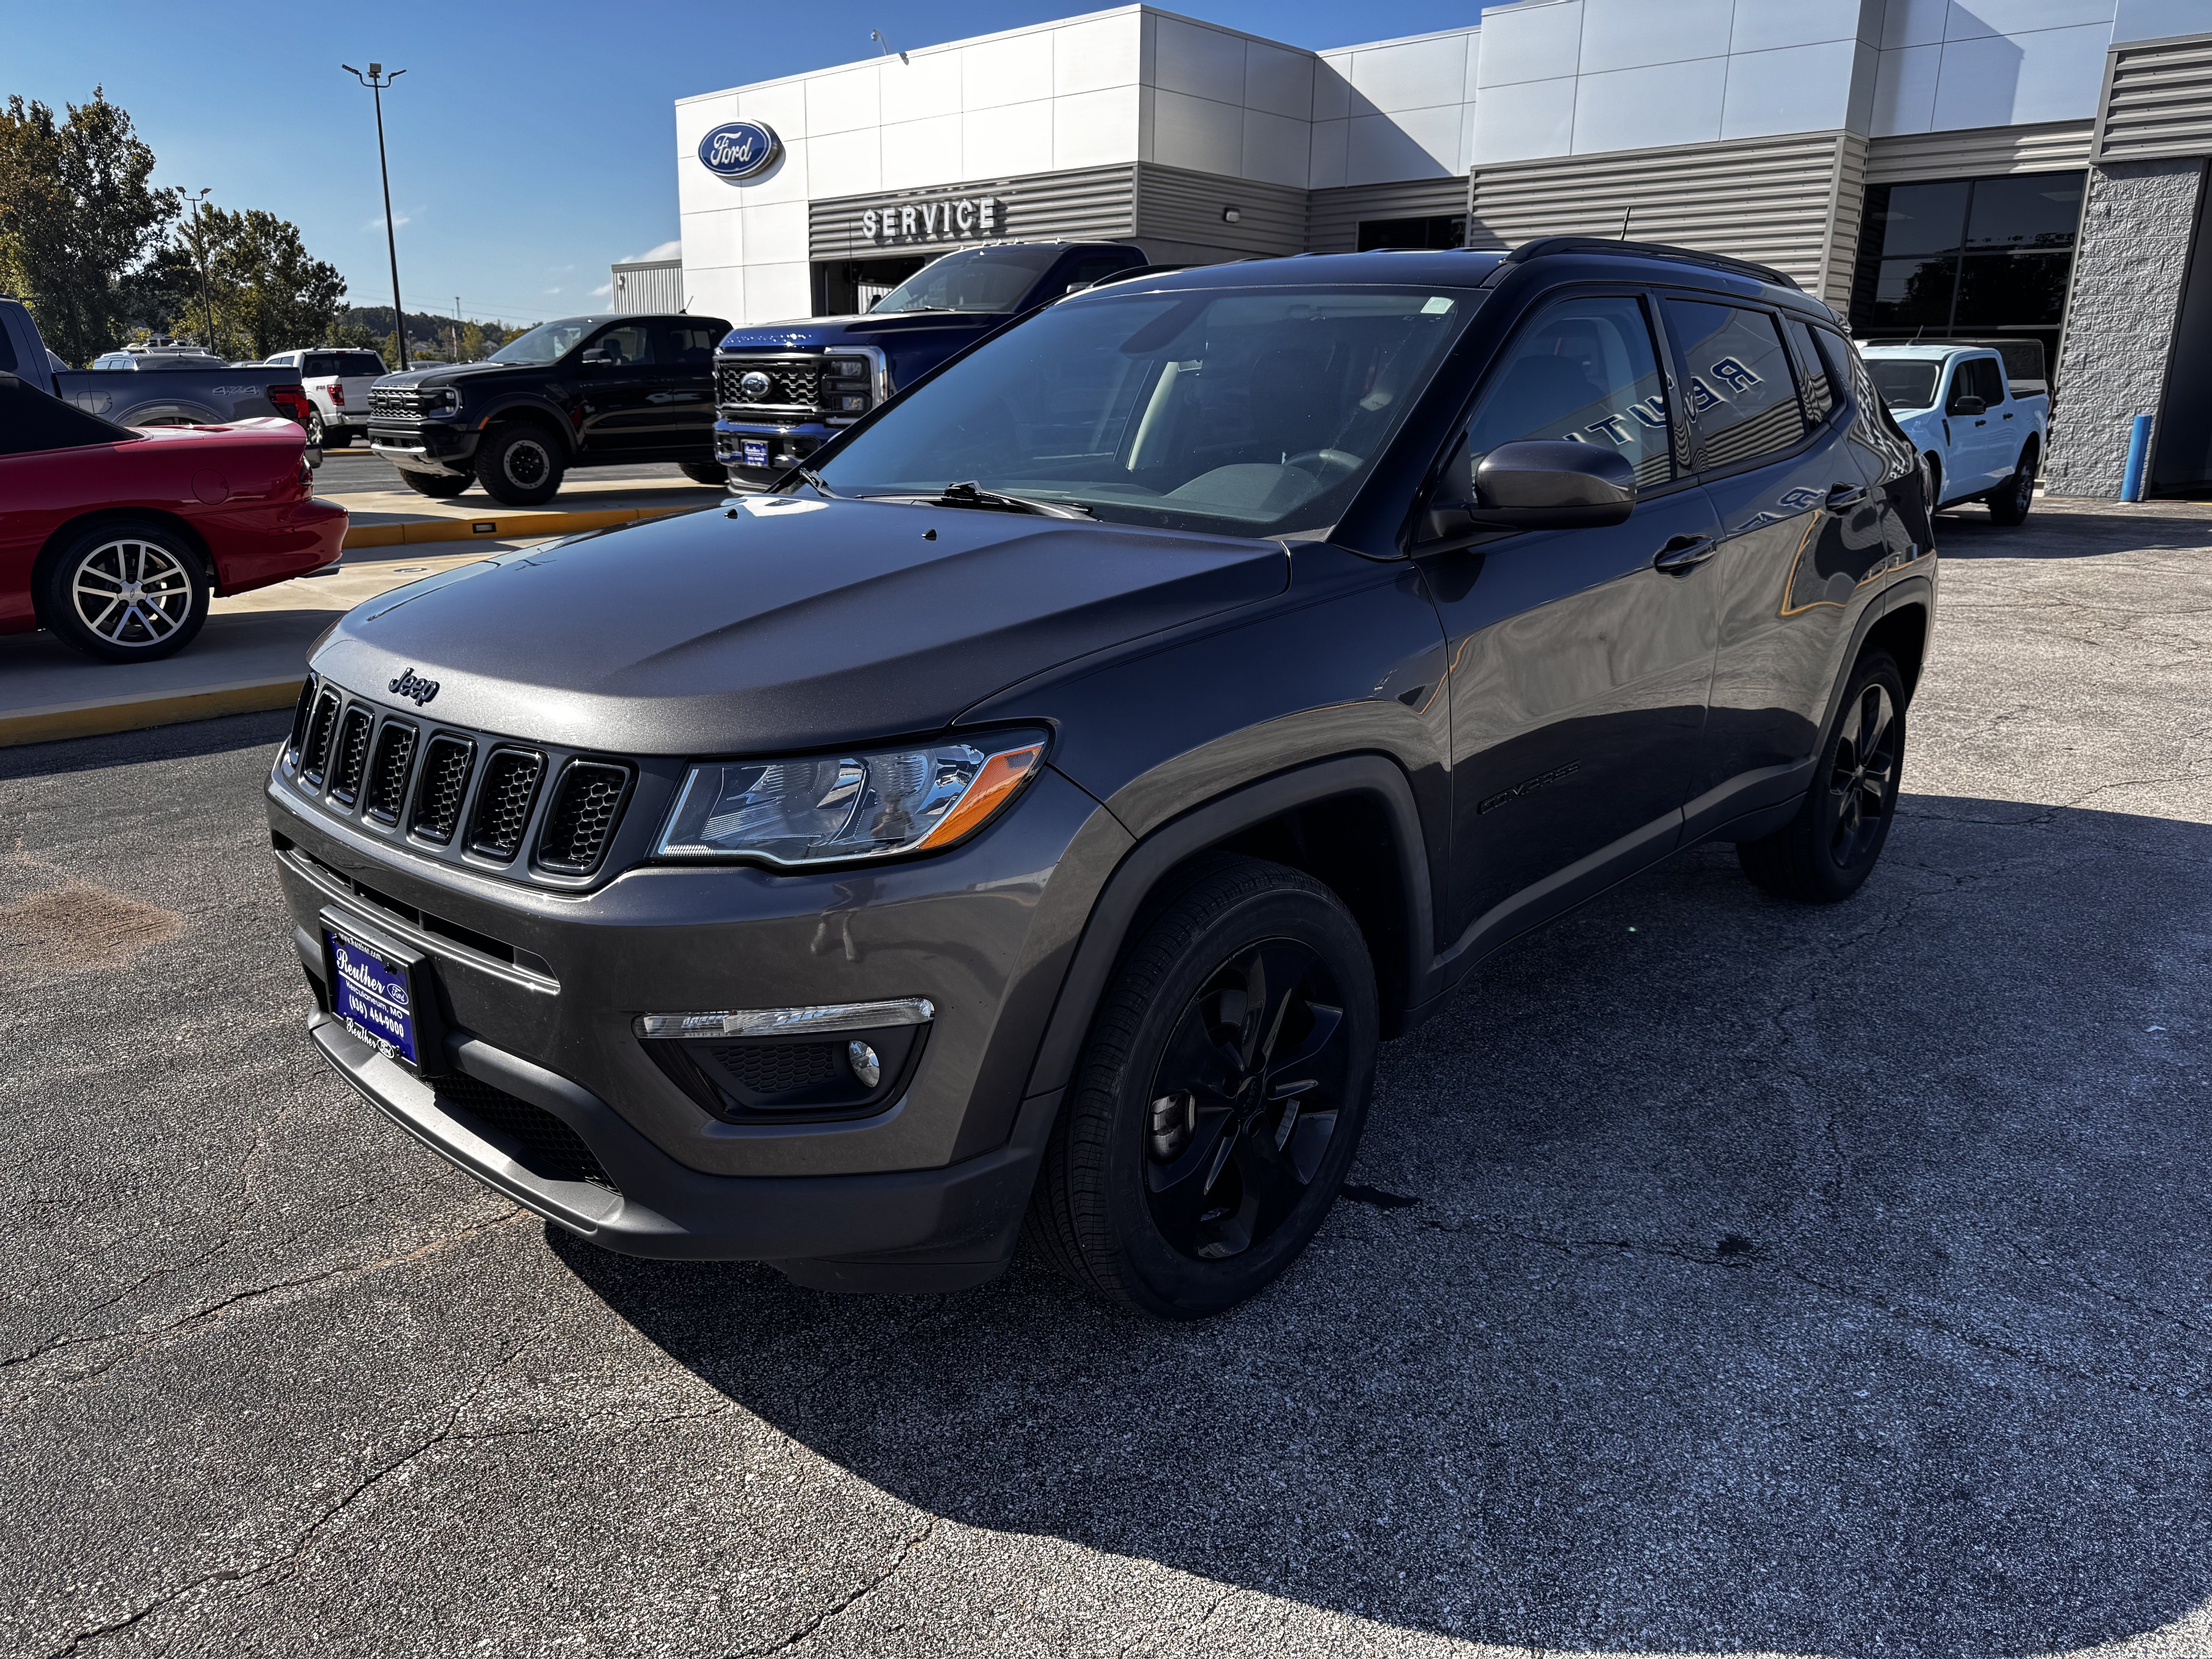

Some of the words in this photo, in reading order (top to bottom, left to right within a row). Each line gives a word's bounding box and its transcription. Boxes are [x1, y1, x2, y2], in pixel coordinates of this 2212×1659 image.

[710, 131, 752, 166] Ford
[862, 198, 996, 238] SERVICE
[388, 667, 440, 707] Jeep
[337, 949, 385, 994] Reuther
[392, 986, 405, 1002] Ford
[346, 980, 389, 1013] Herculaneum,
[390, 1006, 403, 1019] MO
[349, 994, 368, 1019] (636)
[370, 1007, 404, 1038] 464-9000
[346, 1017, 377, 1049] Reuther
[380, 1041, 392, 1056] Ford
